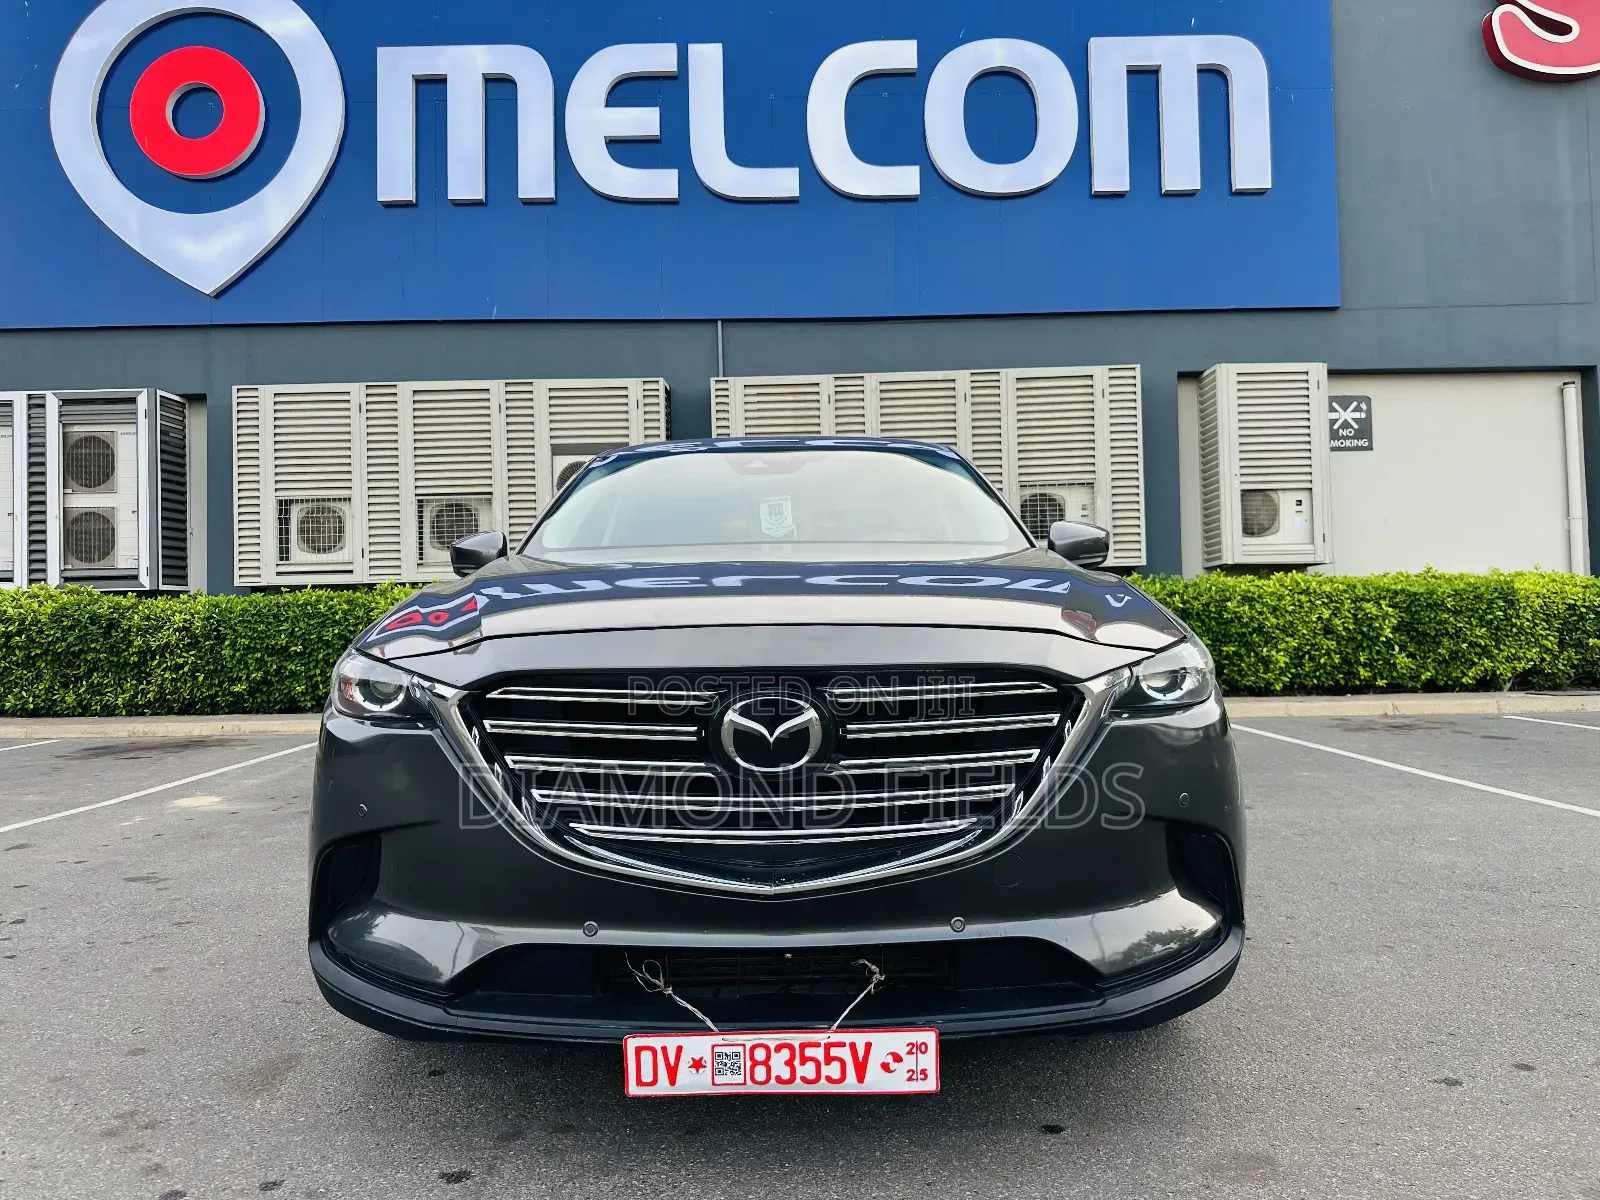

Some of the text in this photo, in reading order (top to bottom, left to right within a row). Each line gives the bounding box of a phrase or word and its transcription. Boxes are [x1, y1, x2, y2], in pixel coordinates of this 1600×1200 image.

[376, 36, 1273, 204] MELCOM
[1329, 438, 1369, 448] MOKING
[1338, 428, 1355, 437] NO
[634, 1040, 873, 1088] DV 8355V
